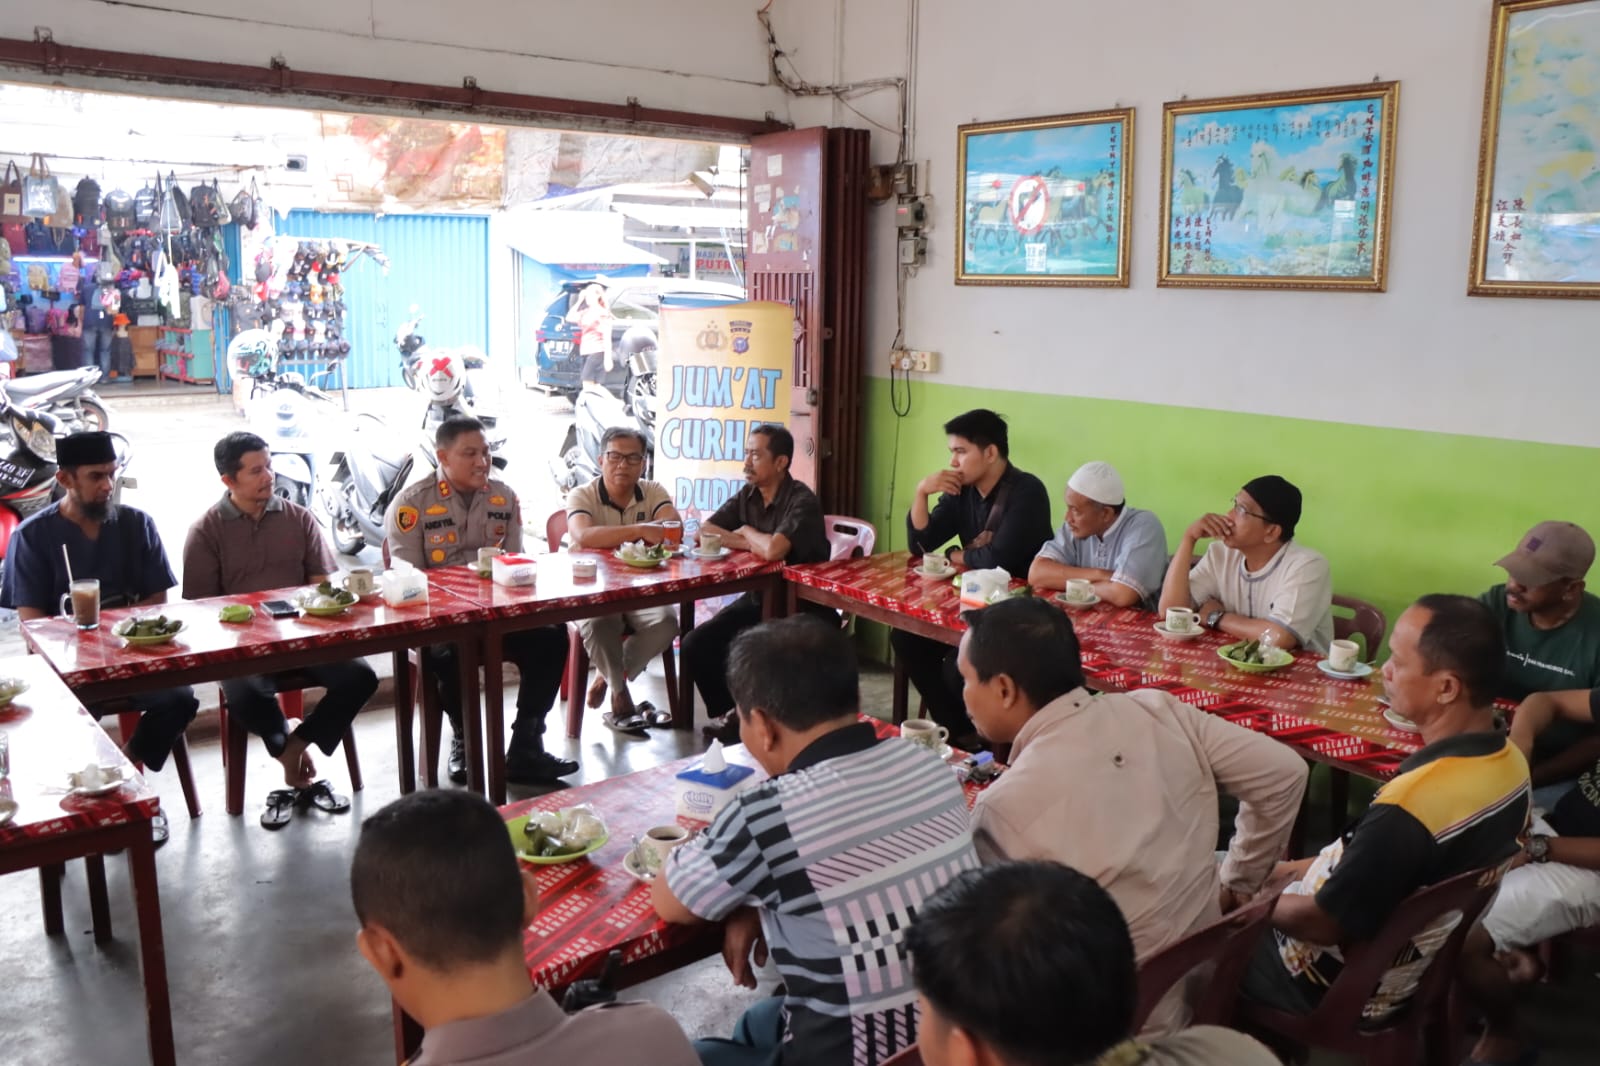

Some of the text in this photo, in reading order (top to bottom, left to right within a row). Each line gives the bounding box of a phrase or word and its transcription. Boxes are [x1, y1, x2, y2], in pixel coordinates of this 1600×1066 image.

[666, 365, 783, 412] JUM'AT
[661, 417, 784, 462] CURH
[1321, 745, 1364, 757] RAHMU!
[528, 894, 582, 933] NYALAKAN
[534, 937, 588, 985] YALAKAN
[544, 940, 602, 992] ERAHMU!
